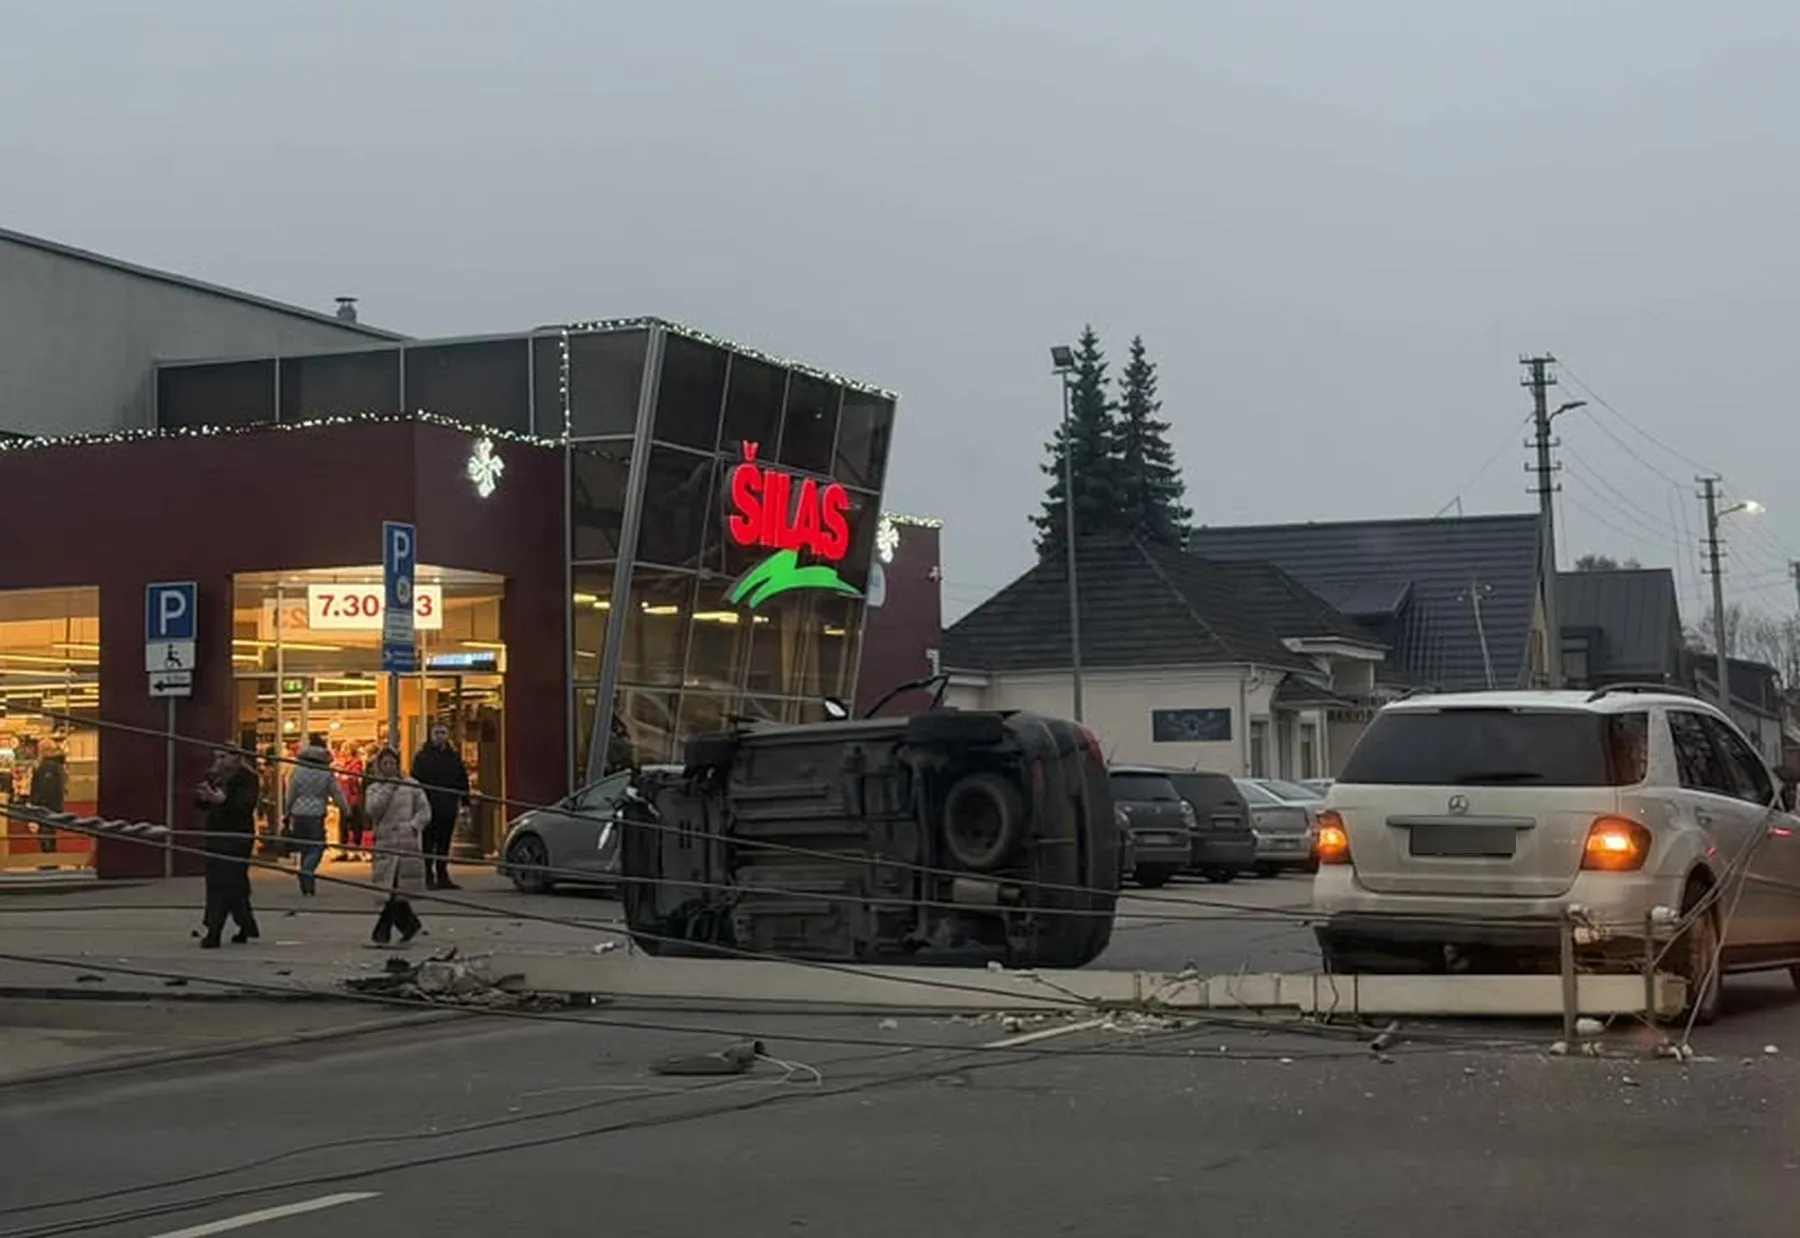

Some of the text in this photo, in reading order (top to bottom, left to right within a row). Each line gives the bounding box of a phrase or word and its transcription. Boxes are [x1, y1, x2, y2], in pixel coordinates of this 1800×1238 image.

[729, 439, 849, 560] ŠILAS
[393, 529, 410, 573] P
[160, 590, 186, 635] P
